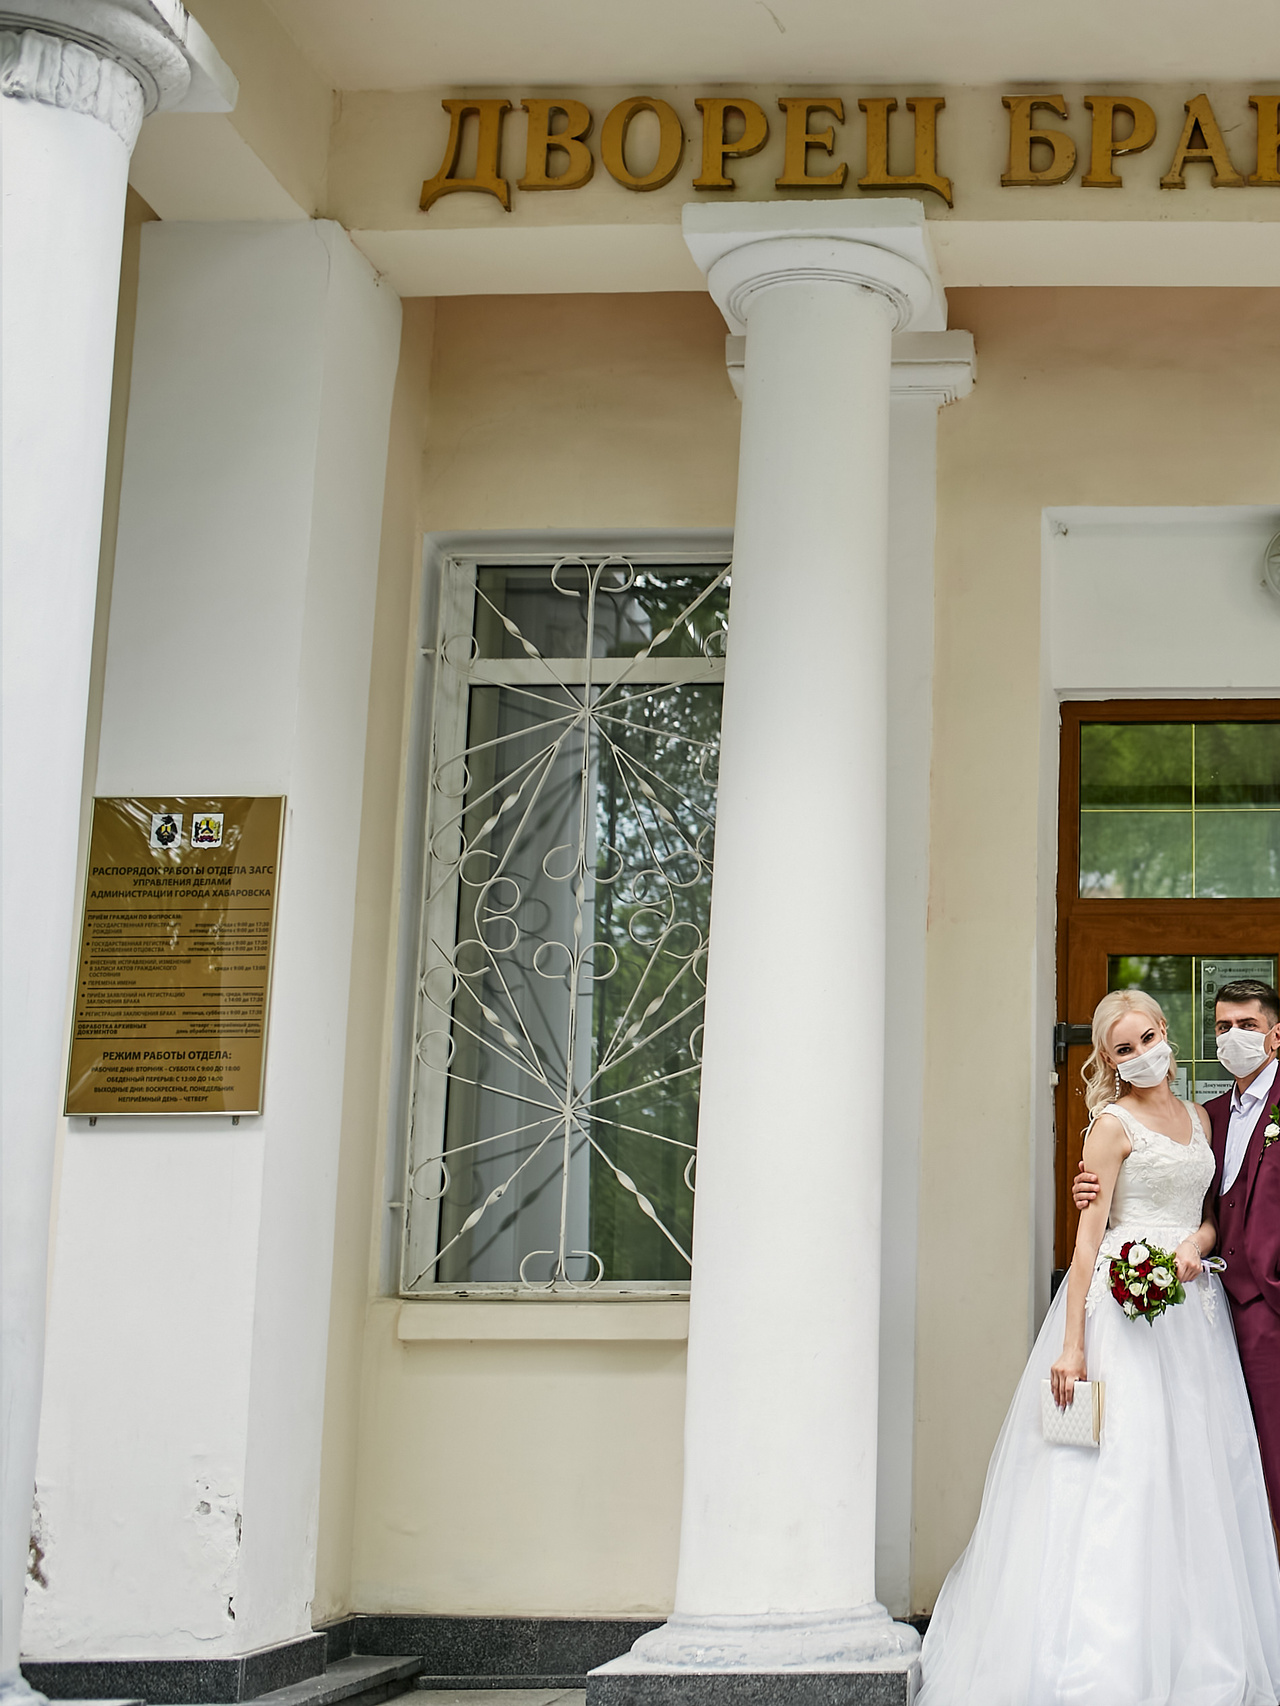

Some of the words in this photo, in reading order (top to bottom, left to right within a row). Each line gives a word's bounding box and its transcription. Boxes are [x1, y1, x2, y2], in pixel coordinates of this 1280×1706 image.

[419, 95, 954, 212] ДВОРЕЦ
[92, 866, 161, 877] РАСПОРЯДОК
[163, 866, 205, 876] РАБОТЫ
[207, 865, 247, 876] ОТДЕЛА
[249, 865, 274, 875] ЗАГС
[133, 878, 191, 887] УПРАВЛЕНИЯ
[193, 878, 231, 887] ДЕЛАМИ
[90, 890, 173, 900] АДМИНИСТРАЦИИ
[175, 889, 210, 899] ГОРОДА
[212, 888, 271, 898] ХАБАРОВСКА
[102, 1051, 141, 1061] РЕЖИМ
[143, 1051, 186, 1060] РАБОТЫ
[187, 1050, 232, 1061] ОТДЕЛА:
